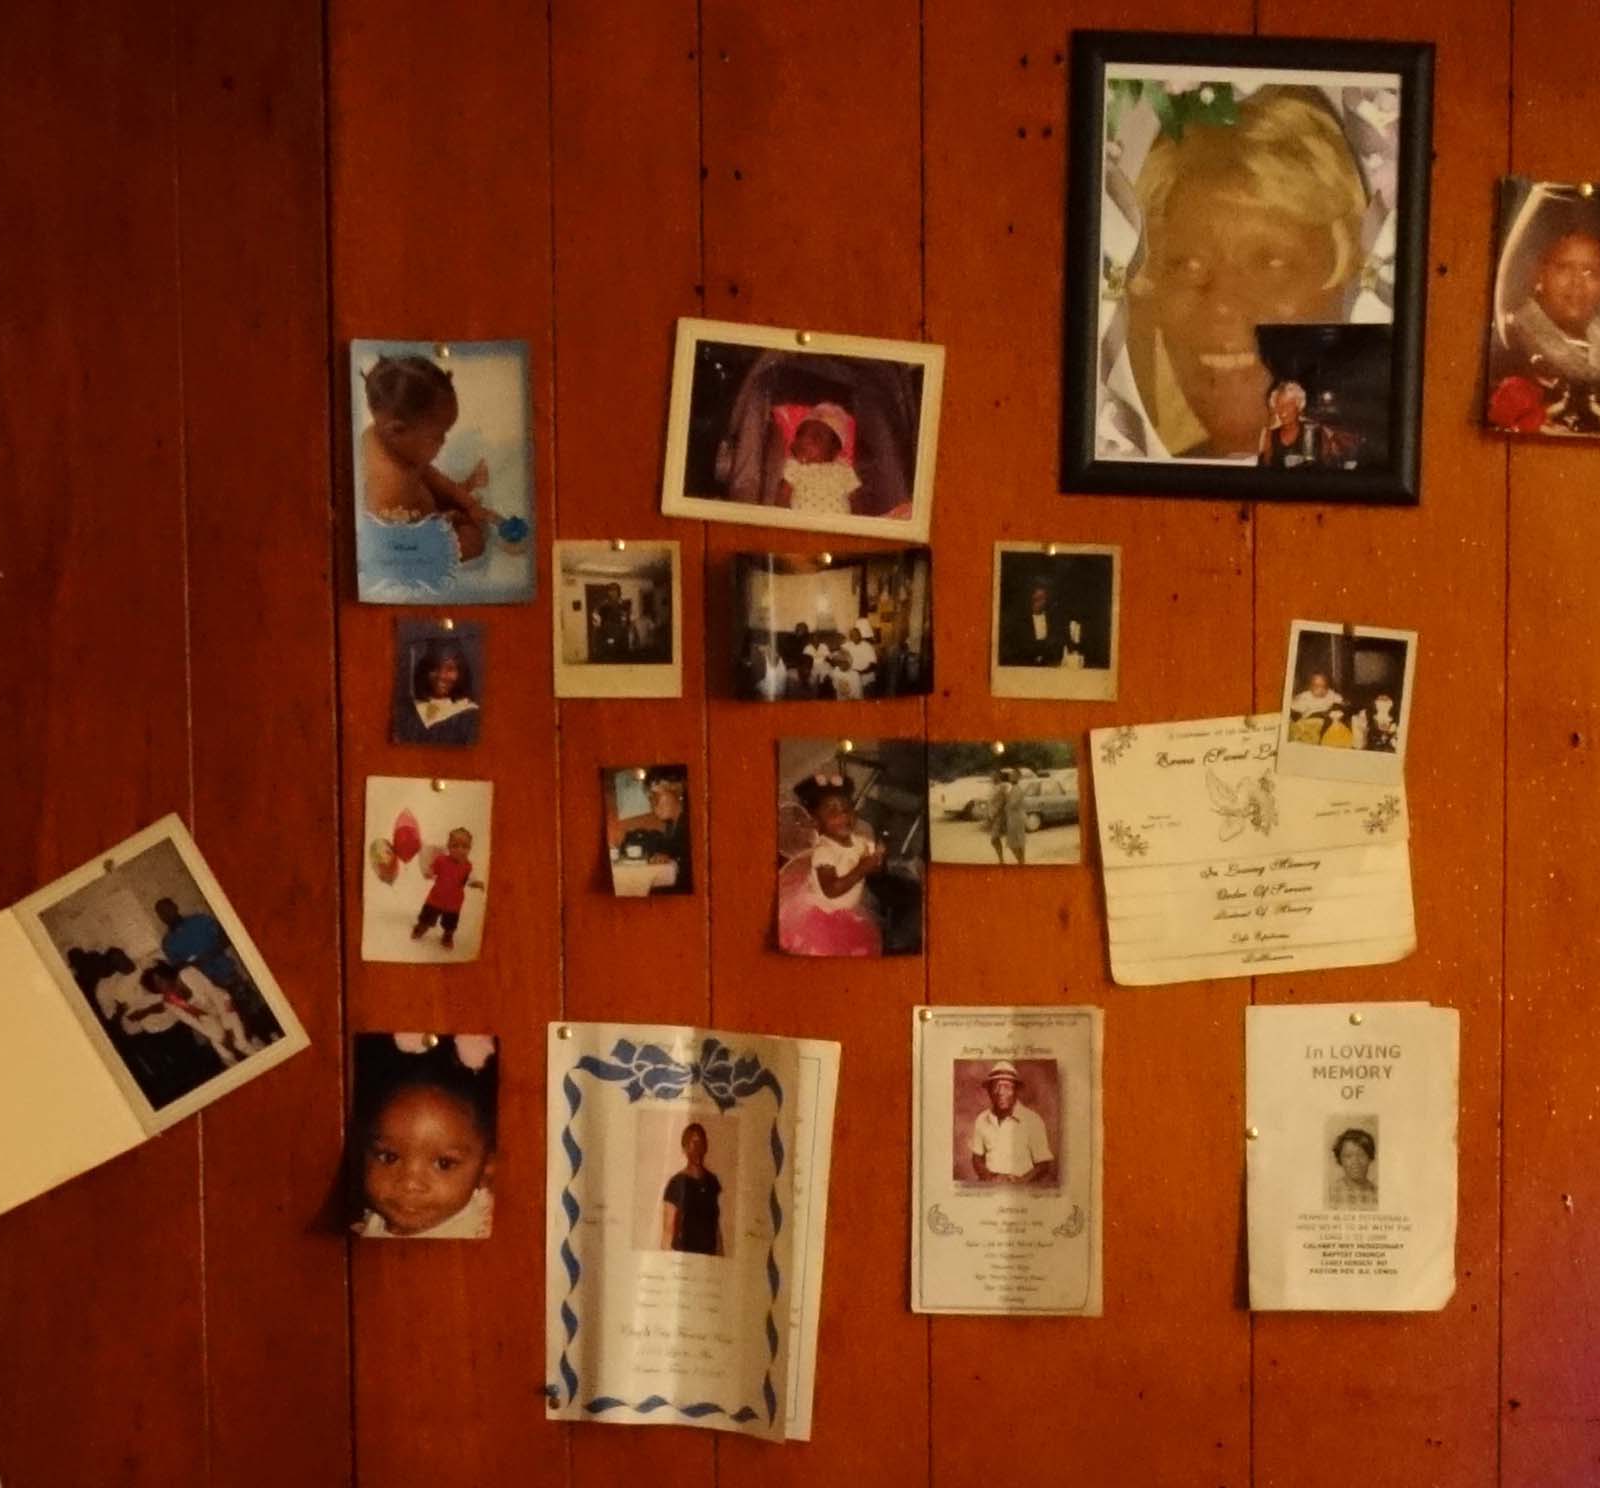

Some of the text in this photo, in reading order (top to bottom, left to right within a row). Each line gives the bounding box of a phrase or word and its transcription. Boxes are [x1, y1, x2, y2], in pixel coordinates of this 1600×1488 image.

[1304, 1044, 1402, 1060] In LOVING
[1311, 1064, 1393, 1080] MEMORY
[1340, 1084, 1366, 1101] OF
